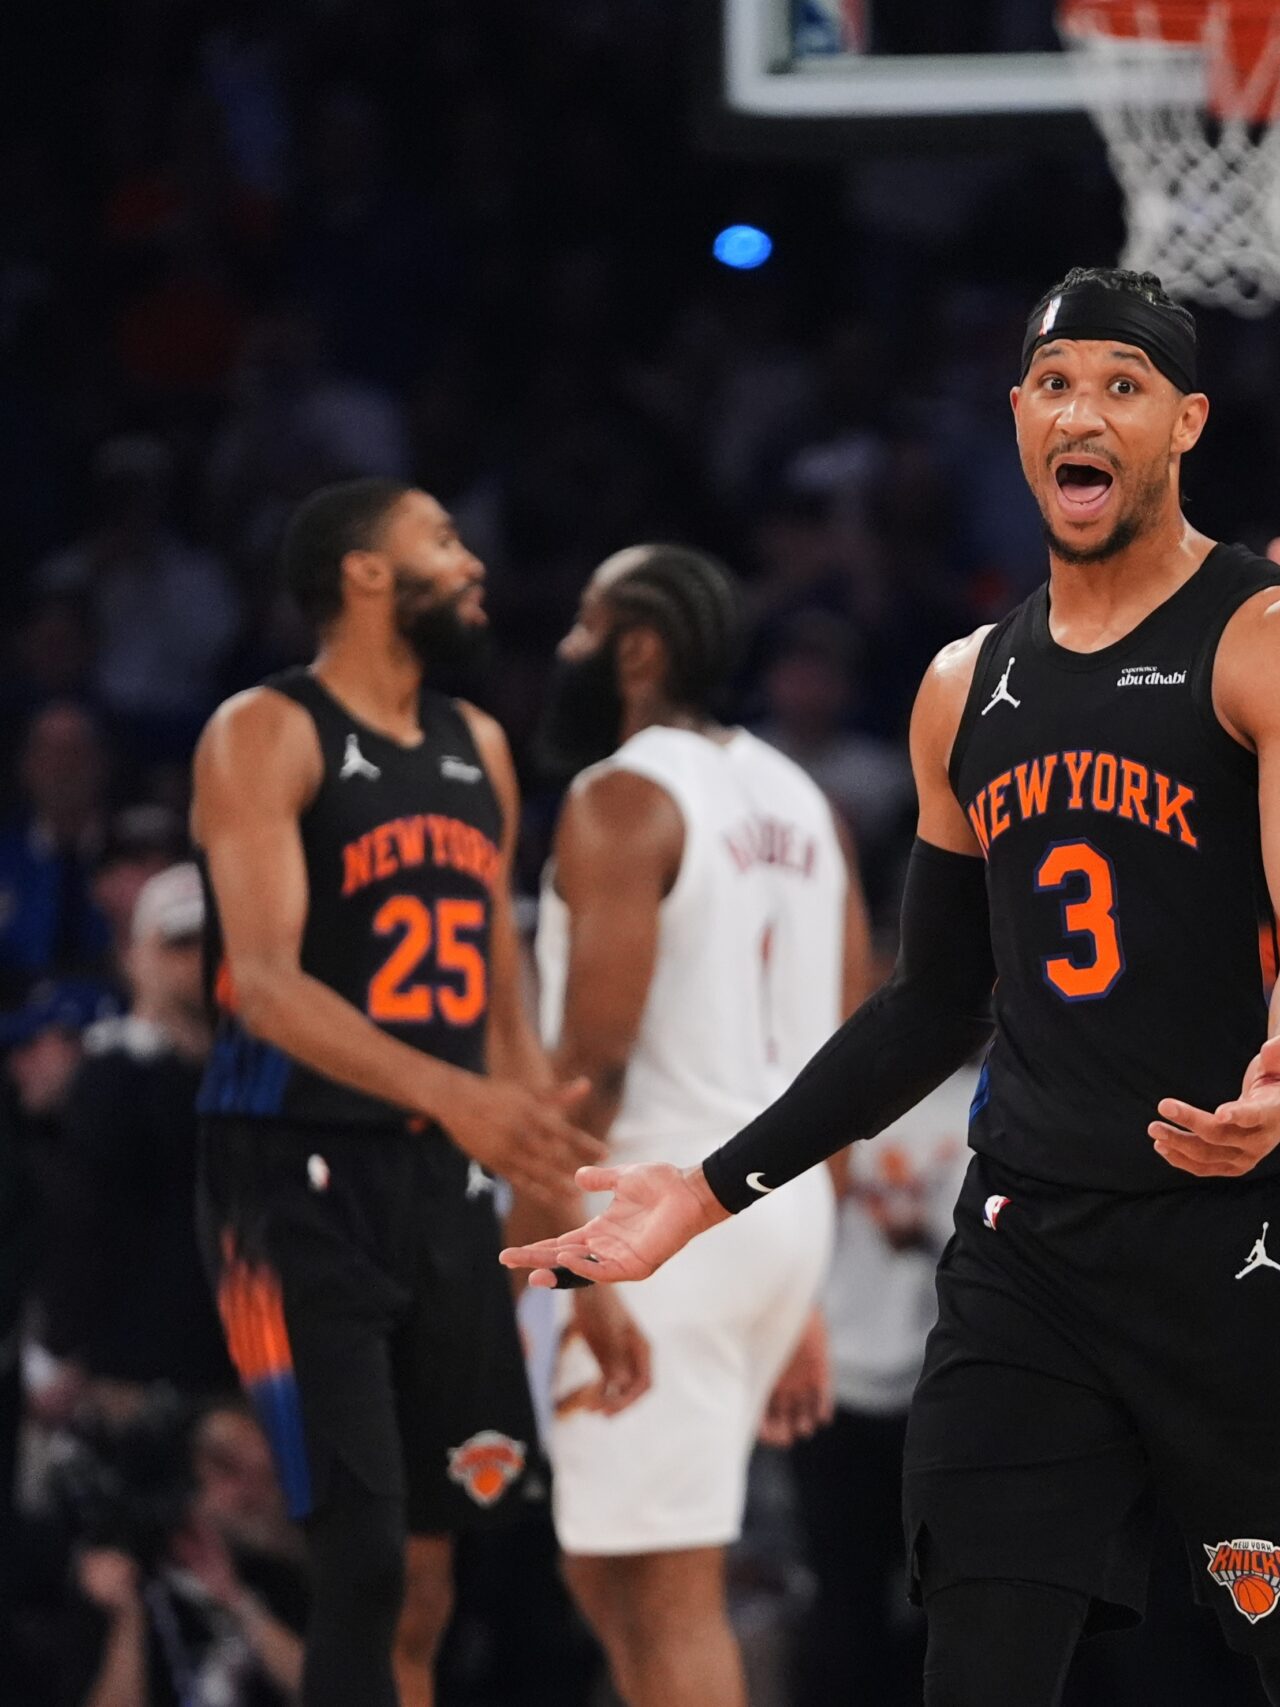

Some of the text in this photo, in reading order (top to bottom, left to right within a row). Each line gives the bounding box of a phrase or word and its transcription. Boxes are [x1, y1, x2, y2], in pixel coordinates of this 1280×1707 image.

[1116, 670, 1187, 687] abu dhabi
[967, 751, 1198, 851] NEW YORK
[341, 814, 426, 896] NEW
[367, 893, 487, 1027] 25
[1035, 838, 1126, 1003] 3
[1232, 1541, 1272, 1552] NEW YORK
